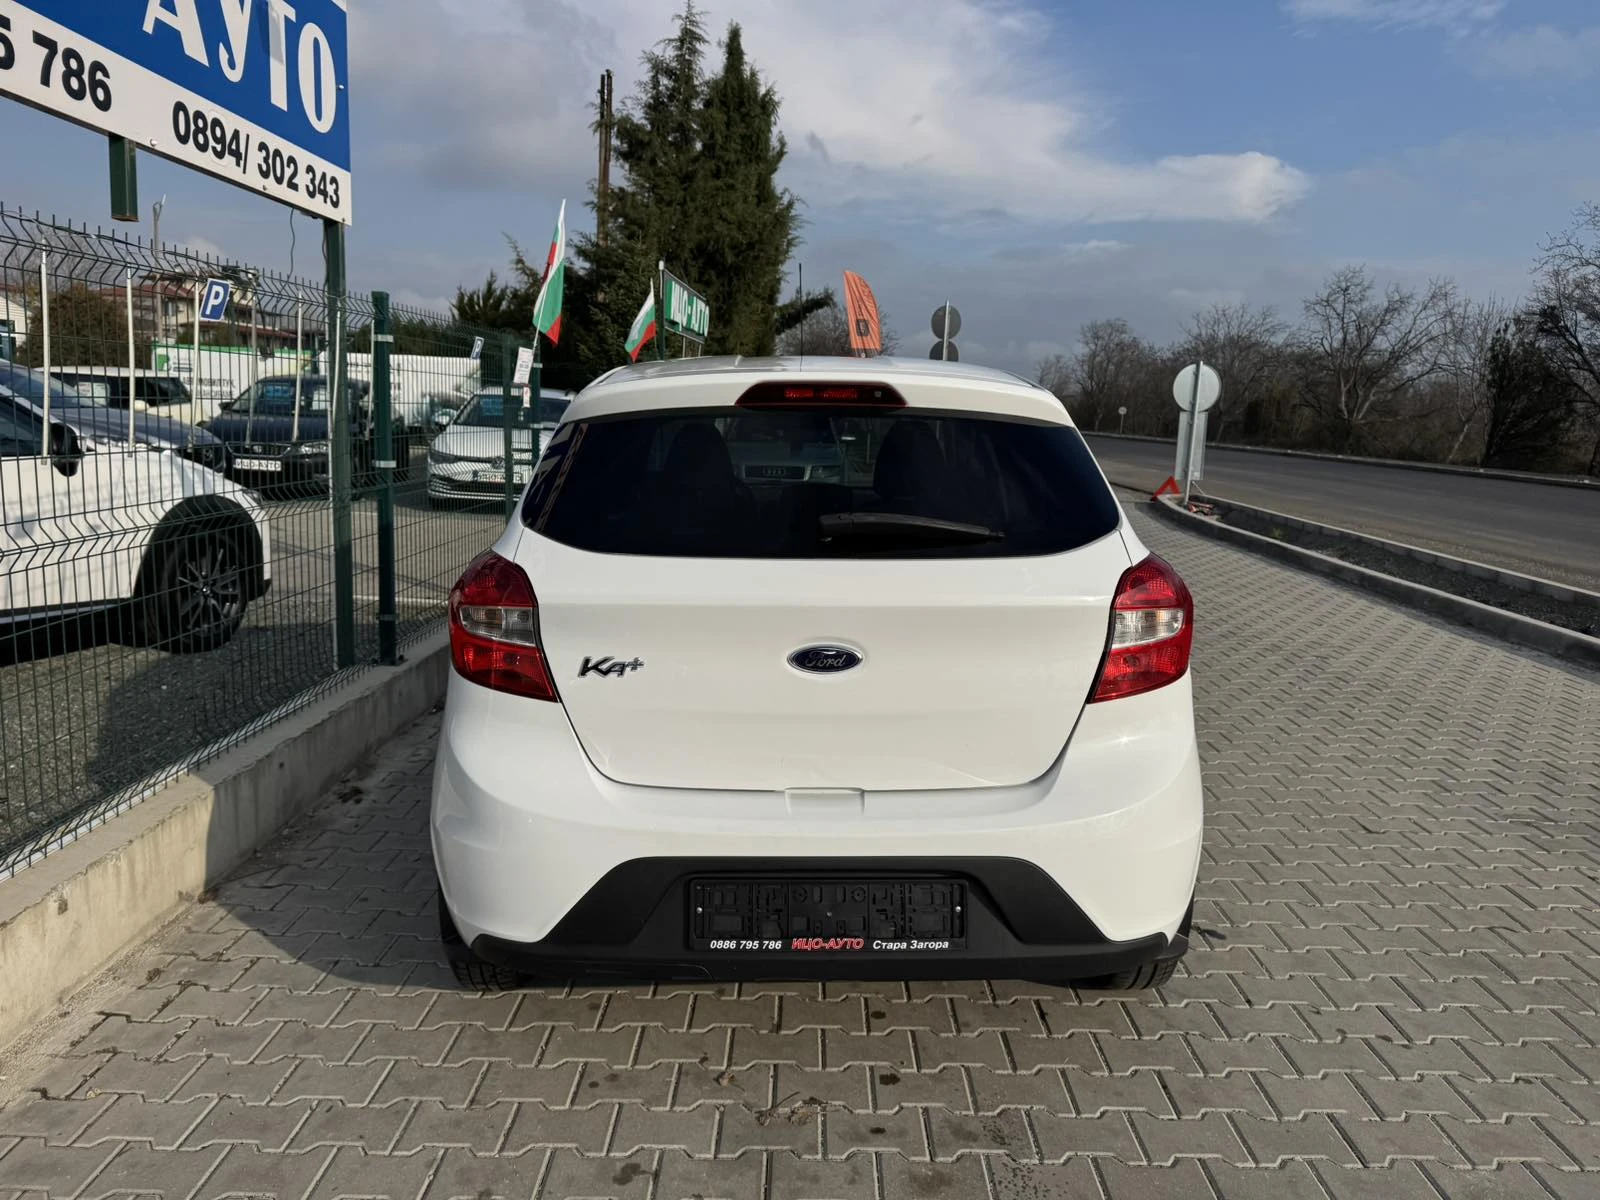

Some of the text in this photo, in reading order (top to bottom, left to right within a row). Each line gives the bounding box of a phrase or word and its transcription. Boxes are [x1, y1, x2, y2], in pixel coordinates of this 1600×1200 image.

[32, 30, 112, 112] 786
[172, 101, 340, 209] 0894/ 302 343
[205, 285, 225, 315] P
[805, 650, 847, 667] Ford
[710, 938, 949, 951] 0886 795 786 ИЦО-АУТО Стара Загора
